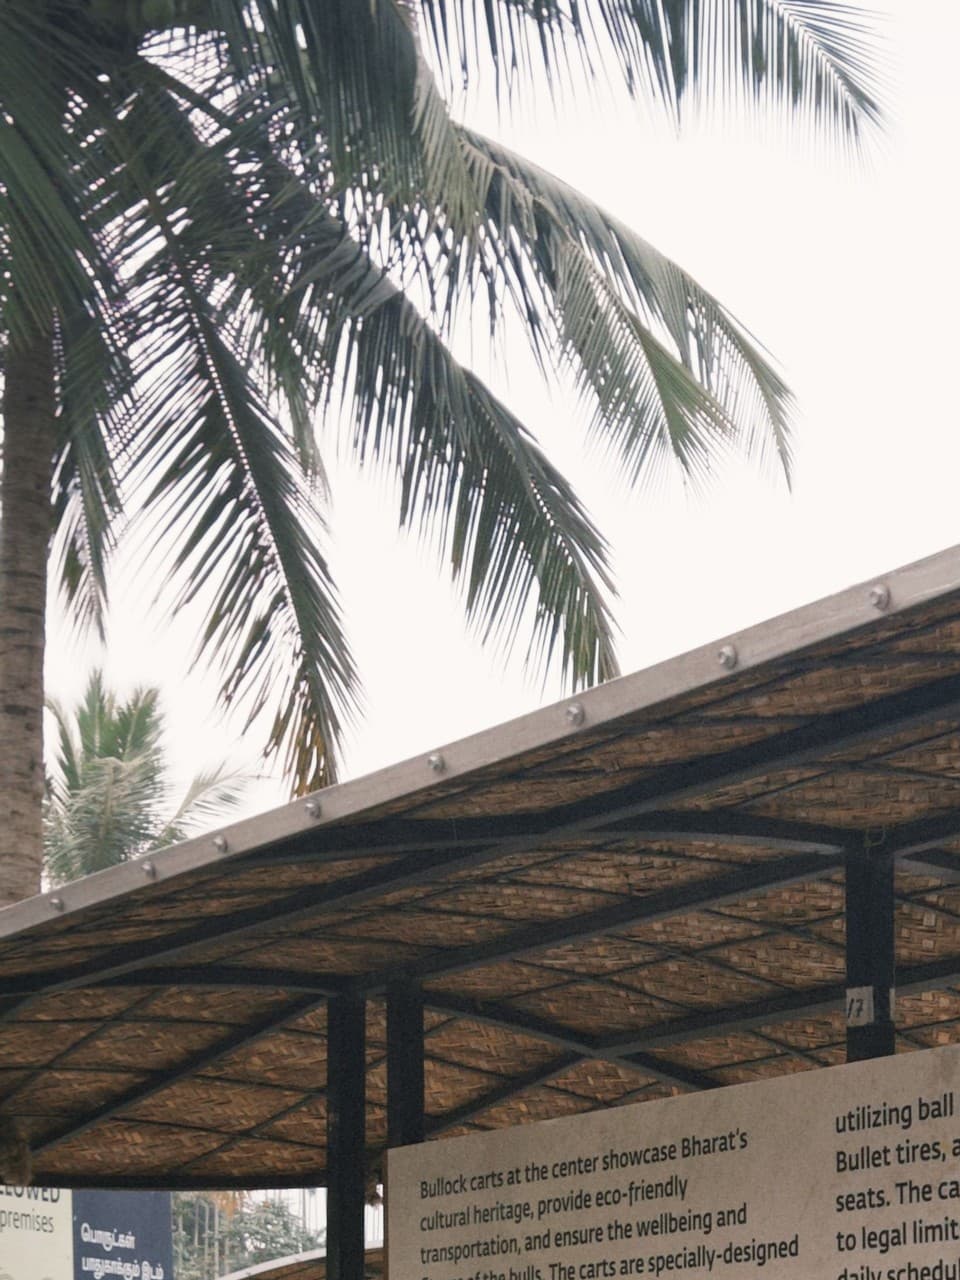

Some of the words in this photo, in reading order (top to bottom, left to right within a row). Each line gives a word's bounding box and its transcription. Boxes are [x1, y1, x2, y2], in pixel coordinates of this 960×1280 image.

[836, 1102, 912, 1133] utilizing
[919, 1092, 953, 1120] ball
[421, 1175, 467, 1199] Bullock
[470, 1172, 503, 1191] carts
[507, 1168, 521, 1185] at
[525, 1163, 548, 1182] the
[552, 1157, 599, 1178] center
[602, 1144, 676, 1171] showcase
[836, 1146, 891, 1173] Bullet
[896, 1139, 946, 1164] tires,
[420, 1207, 470, 1231] cultural
[474, 1202, 533, 1224] heritage,
[538, 1190, 591, 1220] provide
[596, 1175, 688, 1207] eco-friendly
[836, 1188, 890, 1212] seats.
[895, 1180, 932, 1204] The
[0, 1208, 54, 1233] premises
[421, 1235, 520, 1264] transportation,
[525, 1229, 550, 1251] and
[554, 1227, 603, 1247] ensure
[607, 1220, 632, 1241] the
[636, 1209, 712, 1237] wellbeing
[717, 1202, 746, 1227] and
[836, 1232, 856, 1252] to
[862, 1222, 906, 1254] legal
[579, 1260, 616, 1280] carts
[620, 1258, 644, 1275] are
[648, 1234, 798, 1277] specially-designed
